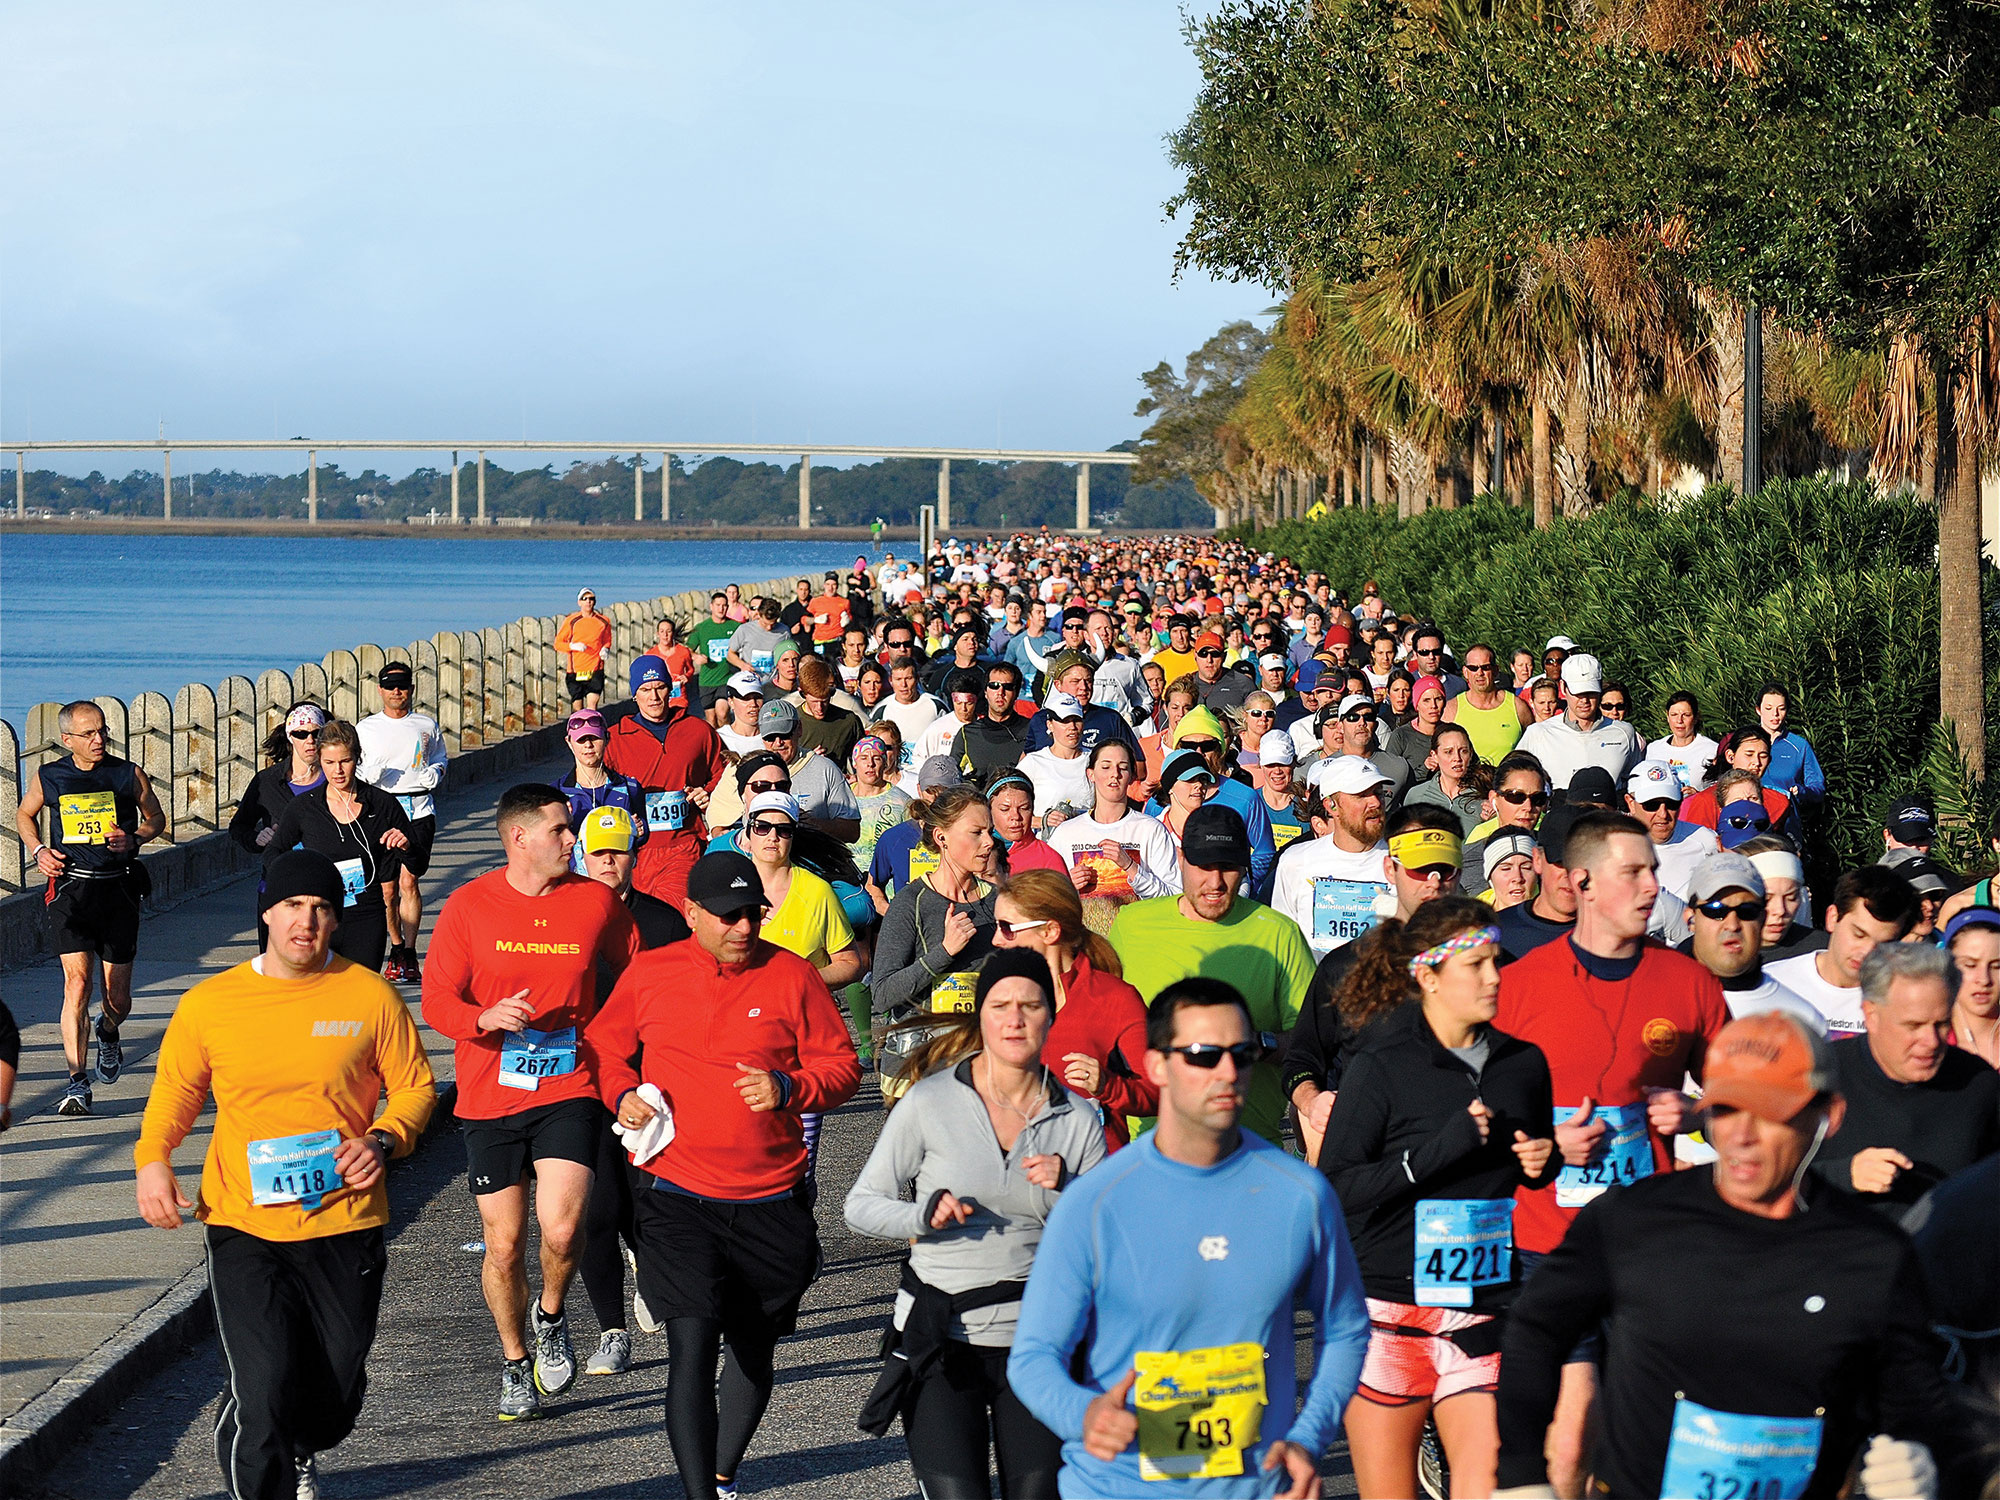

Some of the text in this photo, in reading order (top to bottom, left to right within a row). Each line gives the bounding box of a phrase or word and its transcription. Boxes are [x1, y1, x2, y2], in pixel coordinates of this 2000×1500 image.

[651, 803, 688, 822] 4390
[77, 821, 102, 834] 253
[1071, 843, 1084, 851] 2013
[495, 940, 580, 954] MARINES
[311, 1020, 364, 1037] NAVY
[516, 1056, 560, 1075] 2677
[249, 1154, 287, 1165] Charleston
[289, 1151, 304, 1161] Half
[282, 1159, 308, 1169] TIMOTHY
[1579, 1156, 1637, 1184] 3214
[272, 1169, 325, 1195] 4118
[1425, 1244, 1501, 1282] 4221
[1140, 1382, 1259, 1402] Charleston Marathon
[1175, 1418, 1232, 1451] 793
